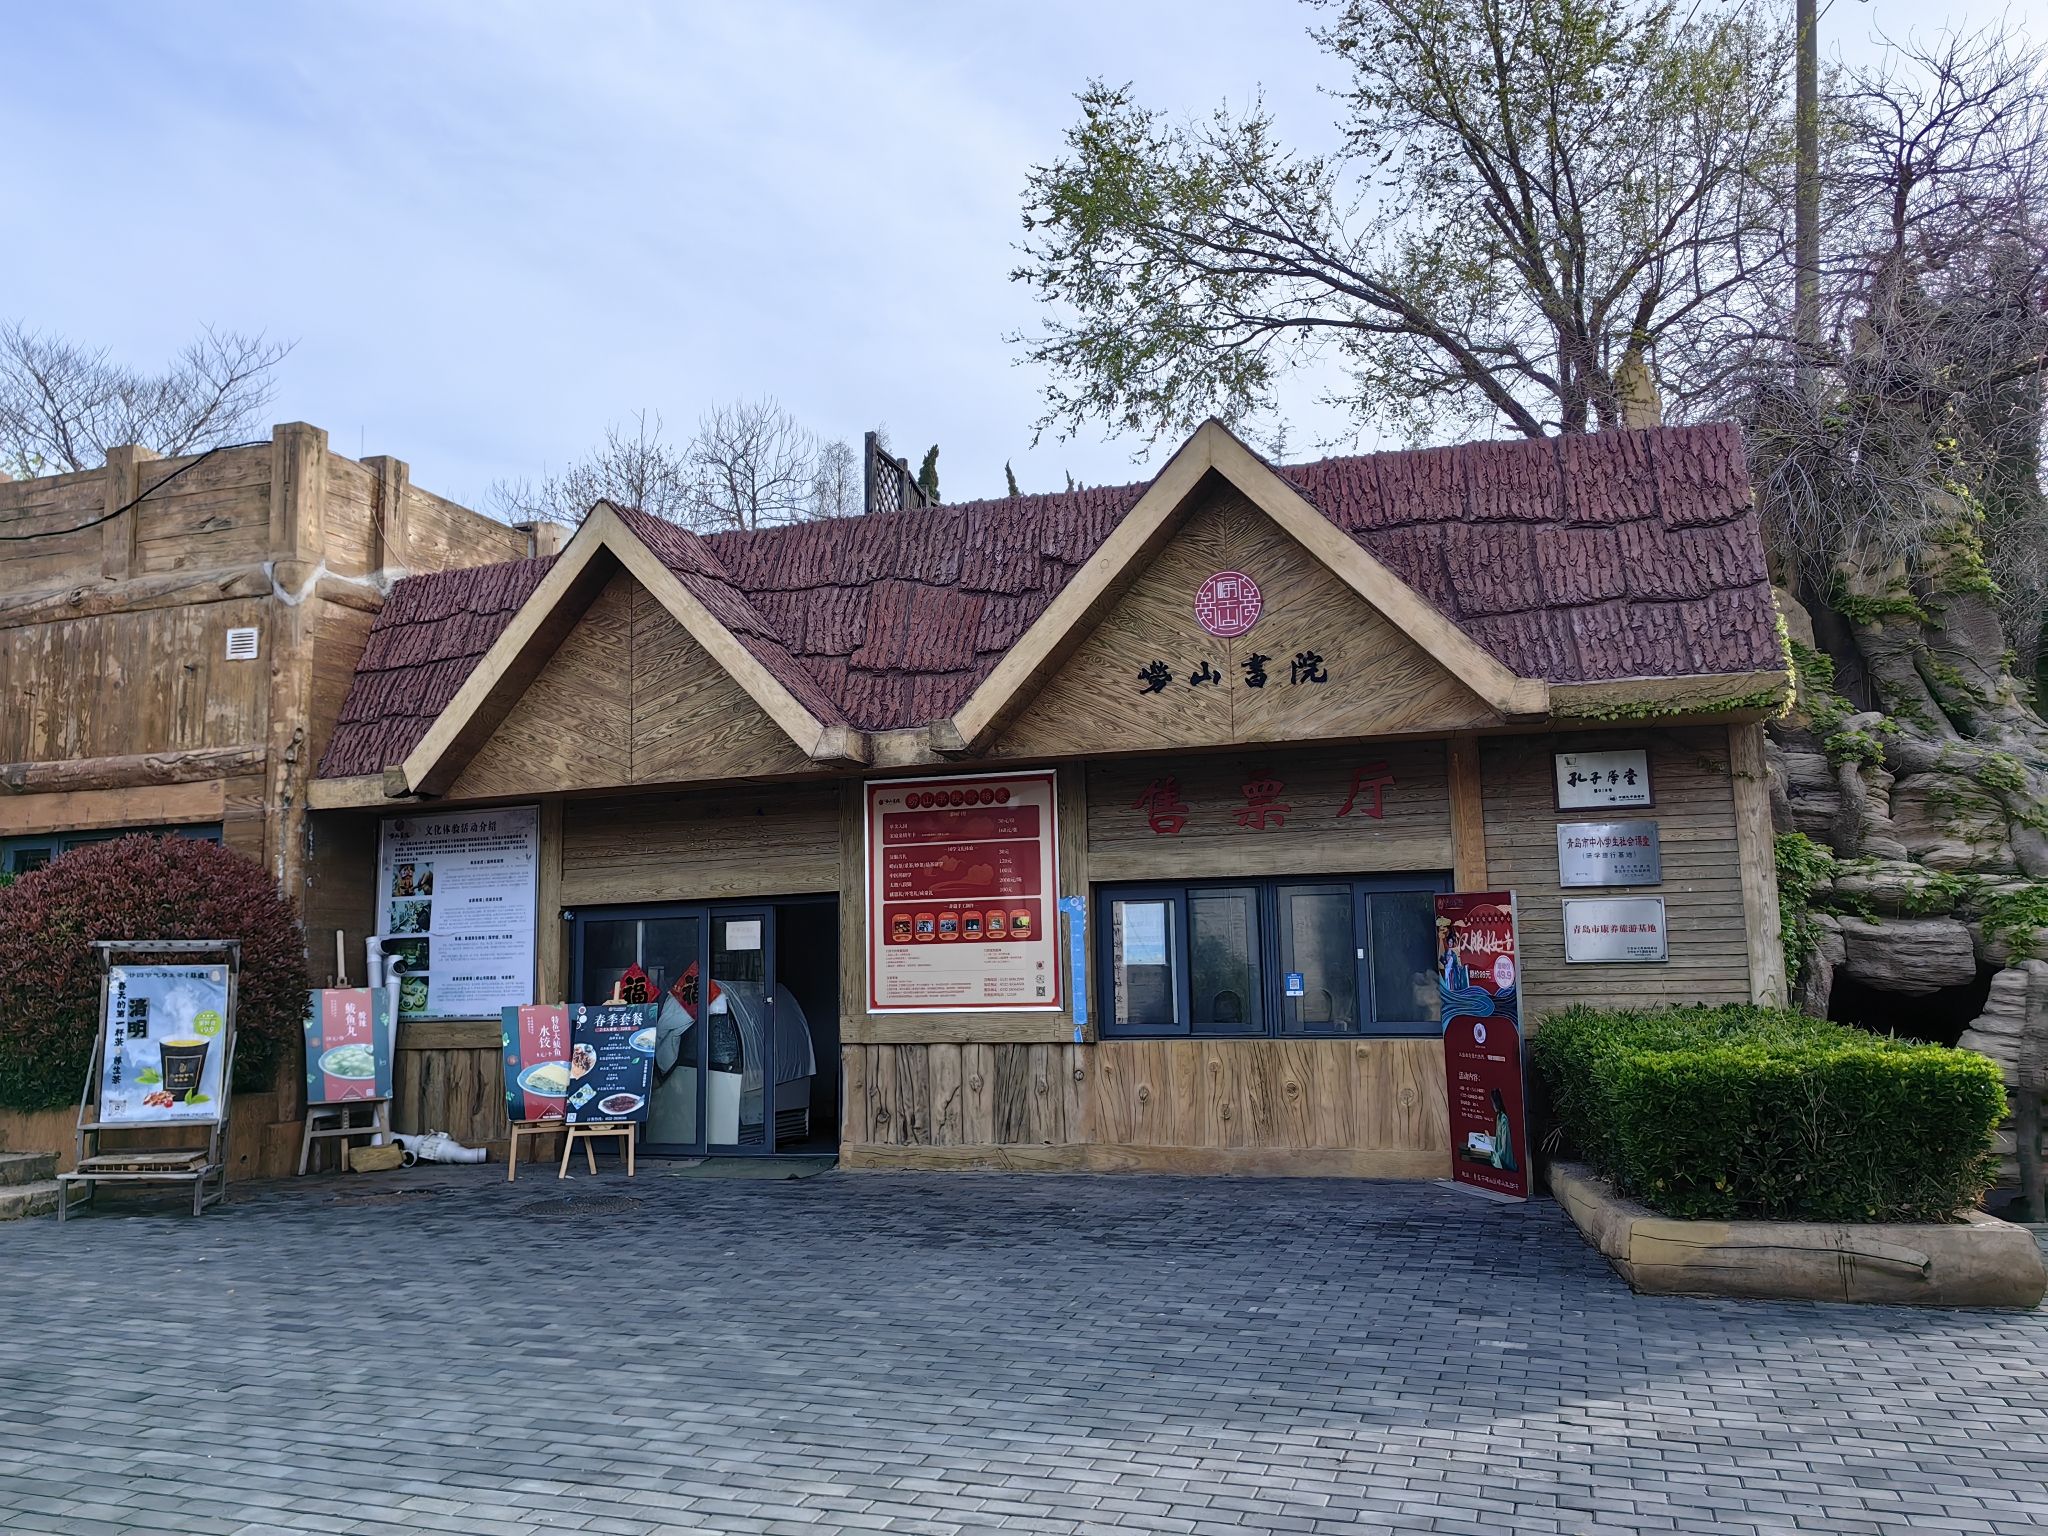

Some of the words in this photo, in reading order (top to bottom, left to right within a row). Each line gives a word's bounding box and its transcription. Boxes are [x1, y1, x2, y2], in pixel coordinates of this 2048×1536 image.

[1131, 760, 1397, 834] 售票厅
[424, 820, 497, 836] 文化体验活动介绍
[1566, 836, 1650, 849] 青岛市中小学生社会课堂
[1573, 923, 1656, 934] 青岛市康养旅游基地
[623, 976, 648, 1003] 福
[127, 998, 148, 1038] 清明
[594, 1012, 643, 1027] 春季套餐
[539, 1025, 551, 1048] 水饺
